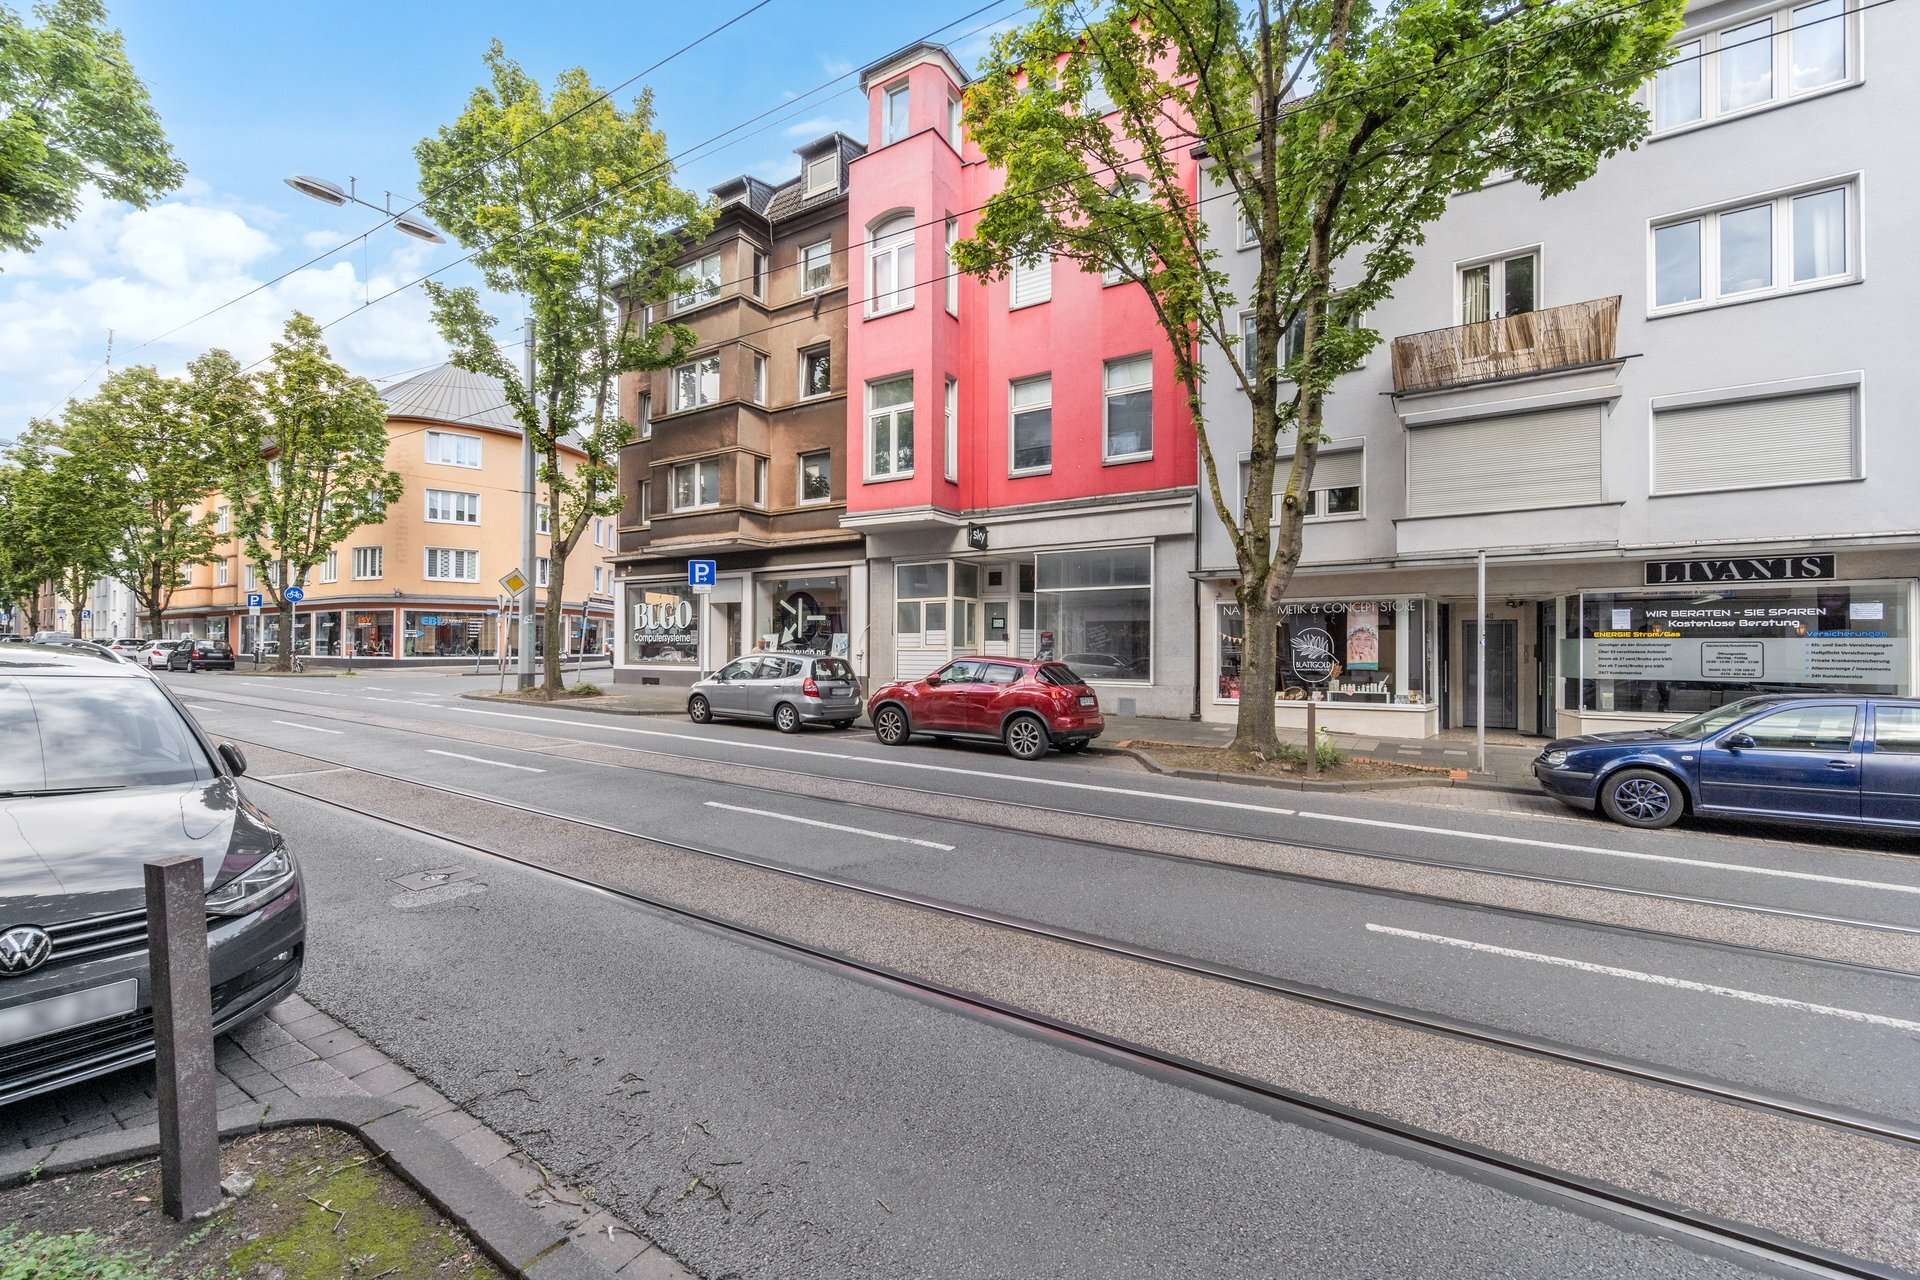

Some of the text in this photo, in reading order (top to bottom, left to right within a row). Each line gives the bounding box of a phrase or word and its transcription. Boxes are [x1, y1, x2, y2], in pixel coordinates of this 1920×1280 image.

[973, 528, 985, 544] sky
[695, 563, 710, 583] P
[1659, 557, 1822, 583] LIVANIS
[250, 595, 260, 606] P
[1323, 602, 1377, 614] CONCEPT
[1380, 600, 1416, 613] STORE
[633, 600, 693, 631] BUGO
[1645, 610, 1668, 618] WIR
[1671, 609, 1731, 618] BERATEN
[1744, 608, 1765, 616] SIE
[1768, 608, 1827, 616] SPAREN
[1668, 619, 1800, 628] Kostenlose Beratung
[633, 633, 691, 643] Computersysteme
